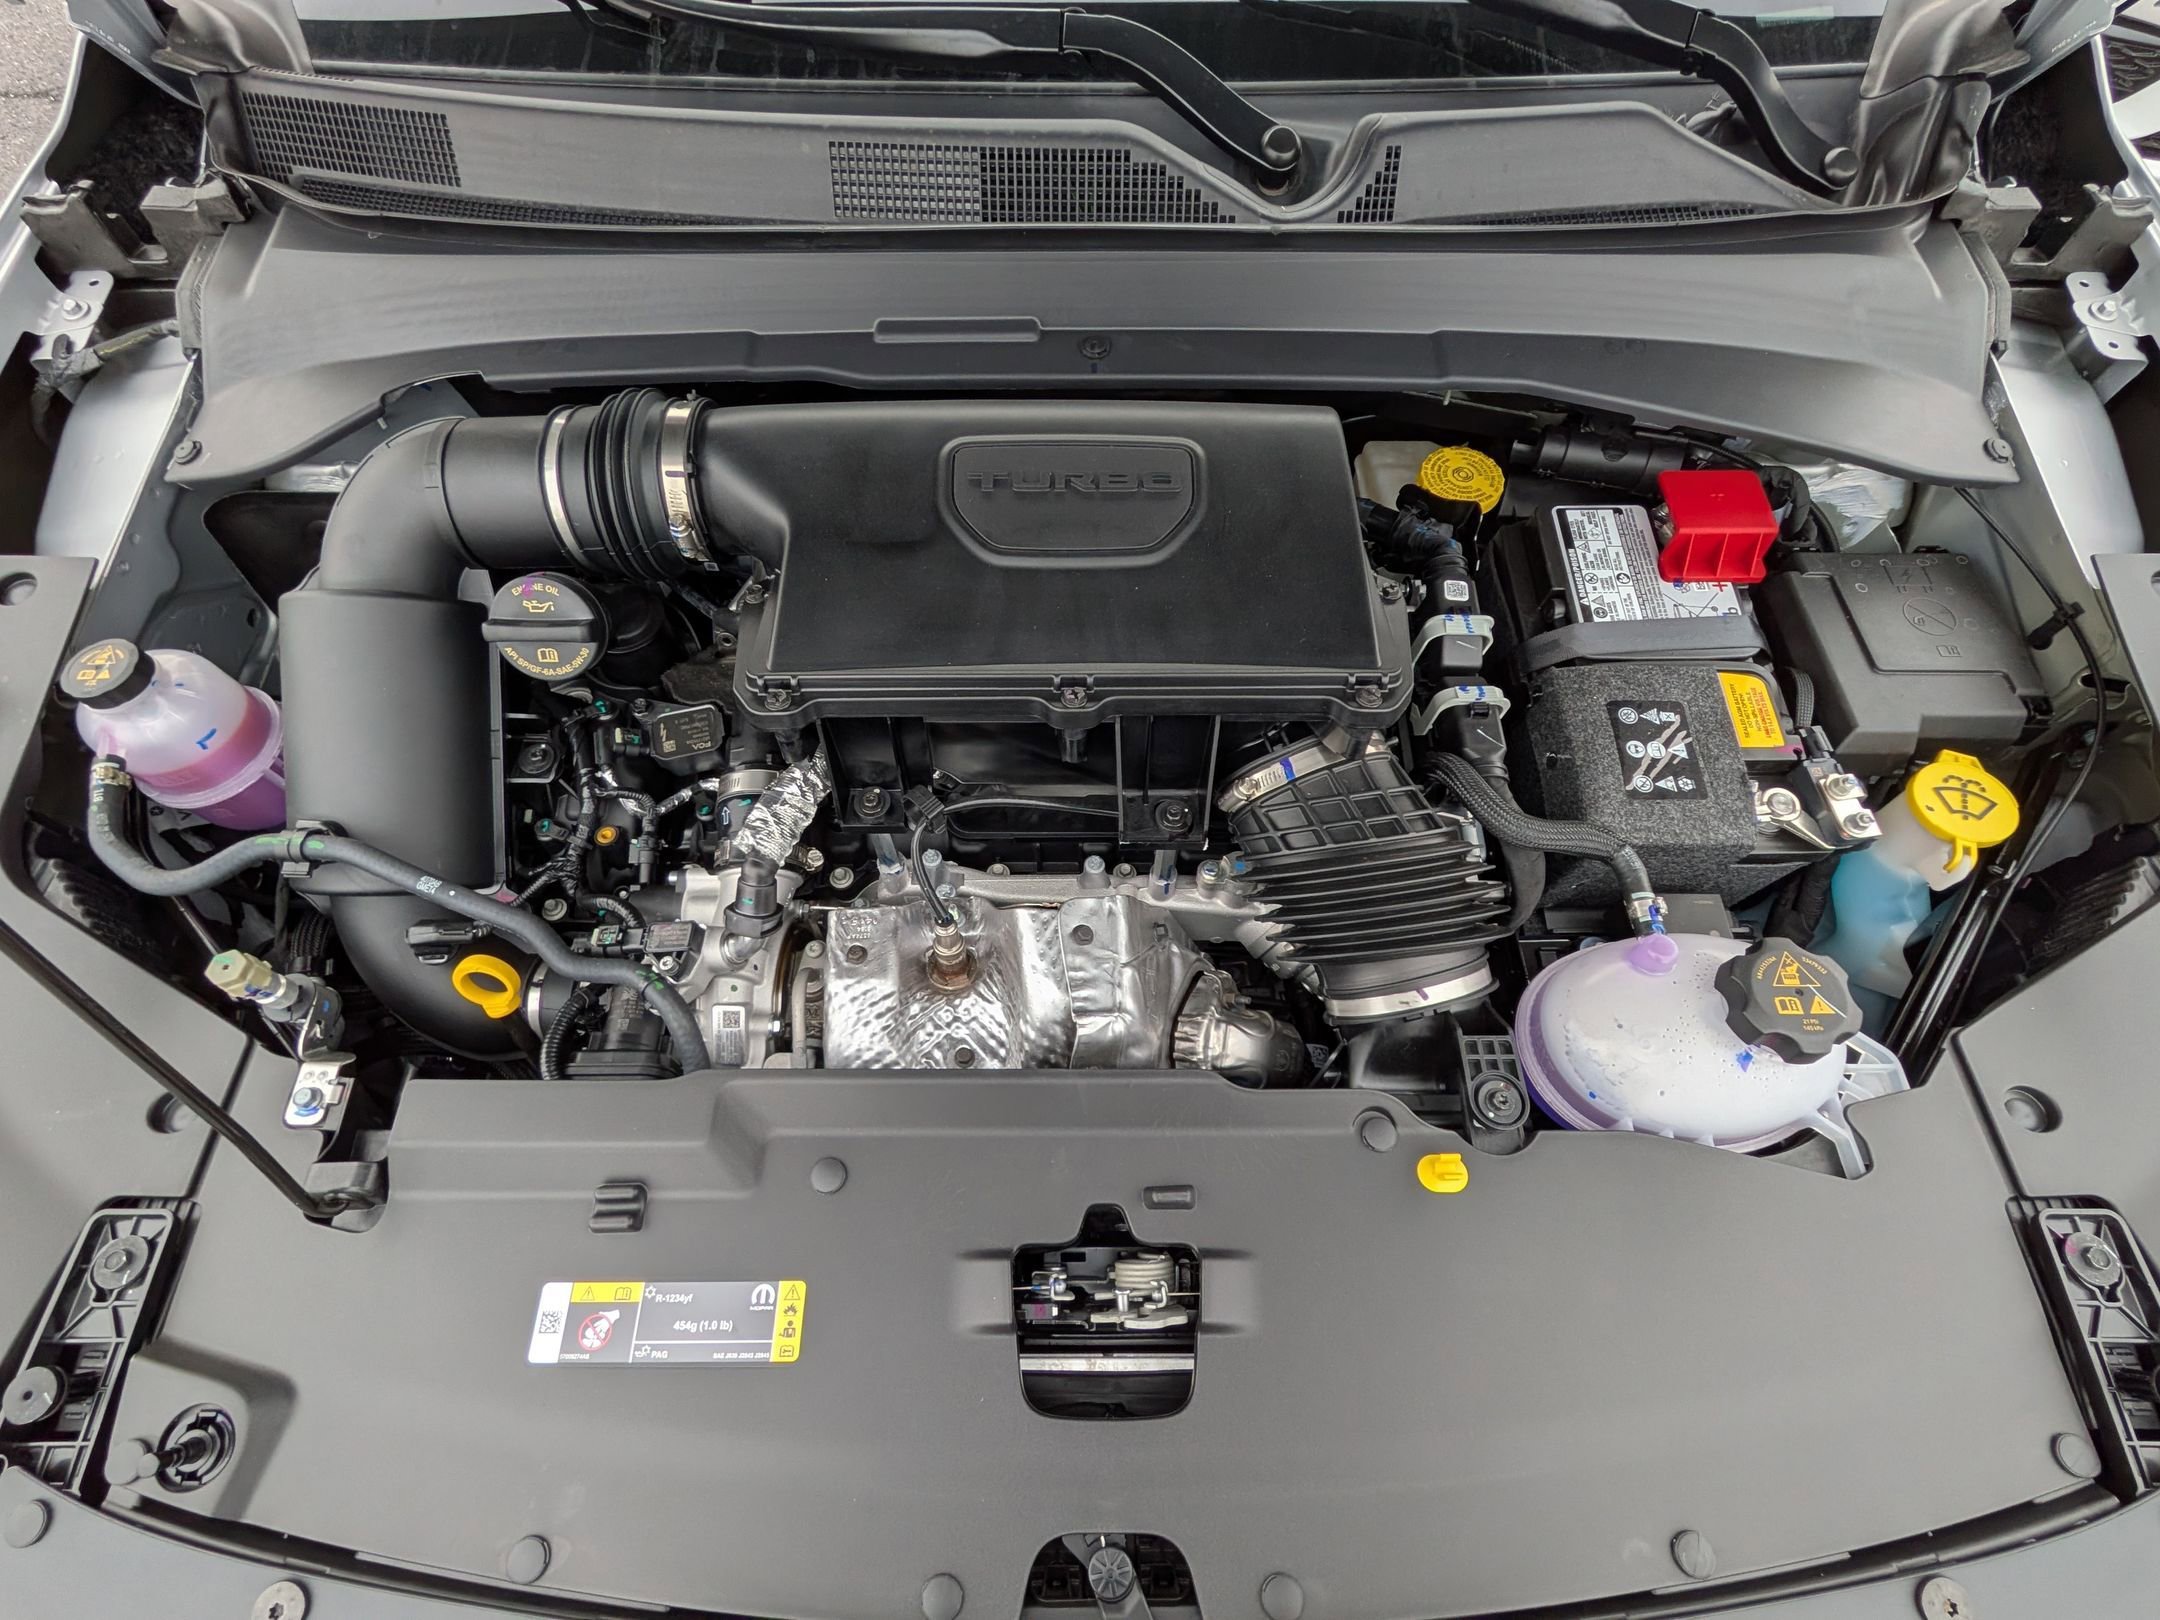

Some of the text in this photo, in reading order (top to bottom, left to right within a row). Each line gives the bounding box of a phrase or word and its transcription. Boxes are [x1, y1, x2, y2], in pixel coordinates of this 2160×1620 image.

[967, 472, 1183, 493] TURBO
[1568, 549, 1586, 597] DANGER/POISON
[511, 583, 560, 597] ENNE OIL
[505, 646, 518, 660] API
[692, 741, 712, 750] FCA
[655, 1294, 693, 1305] R-1234yf
[672, 1320, 732, 1333] 454g (1.0 lb)
[650, 1349, 669, 1359] PAG
